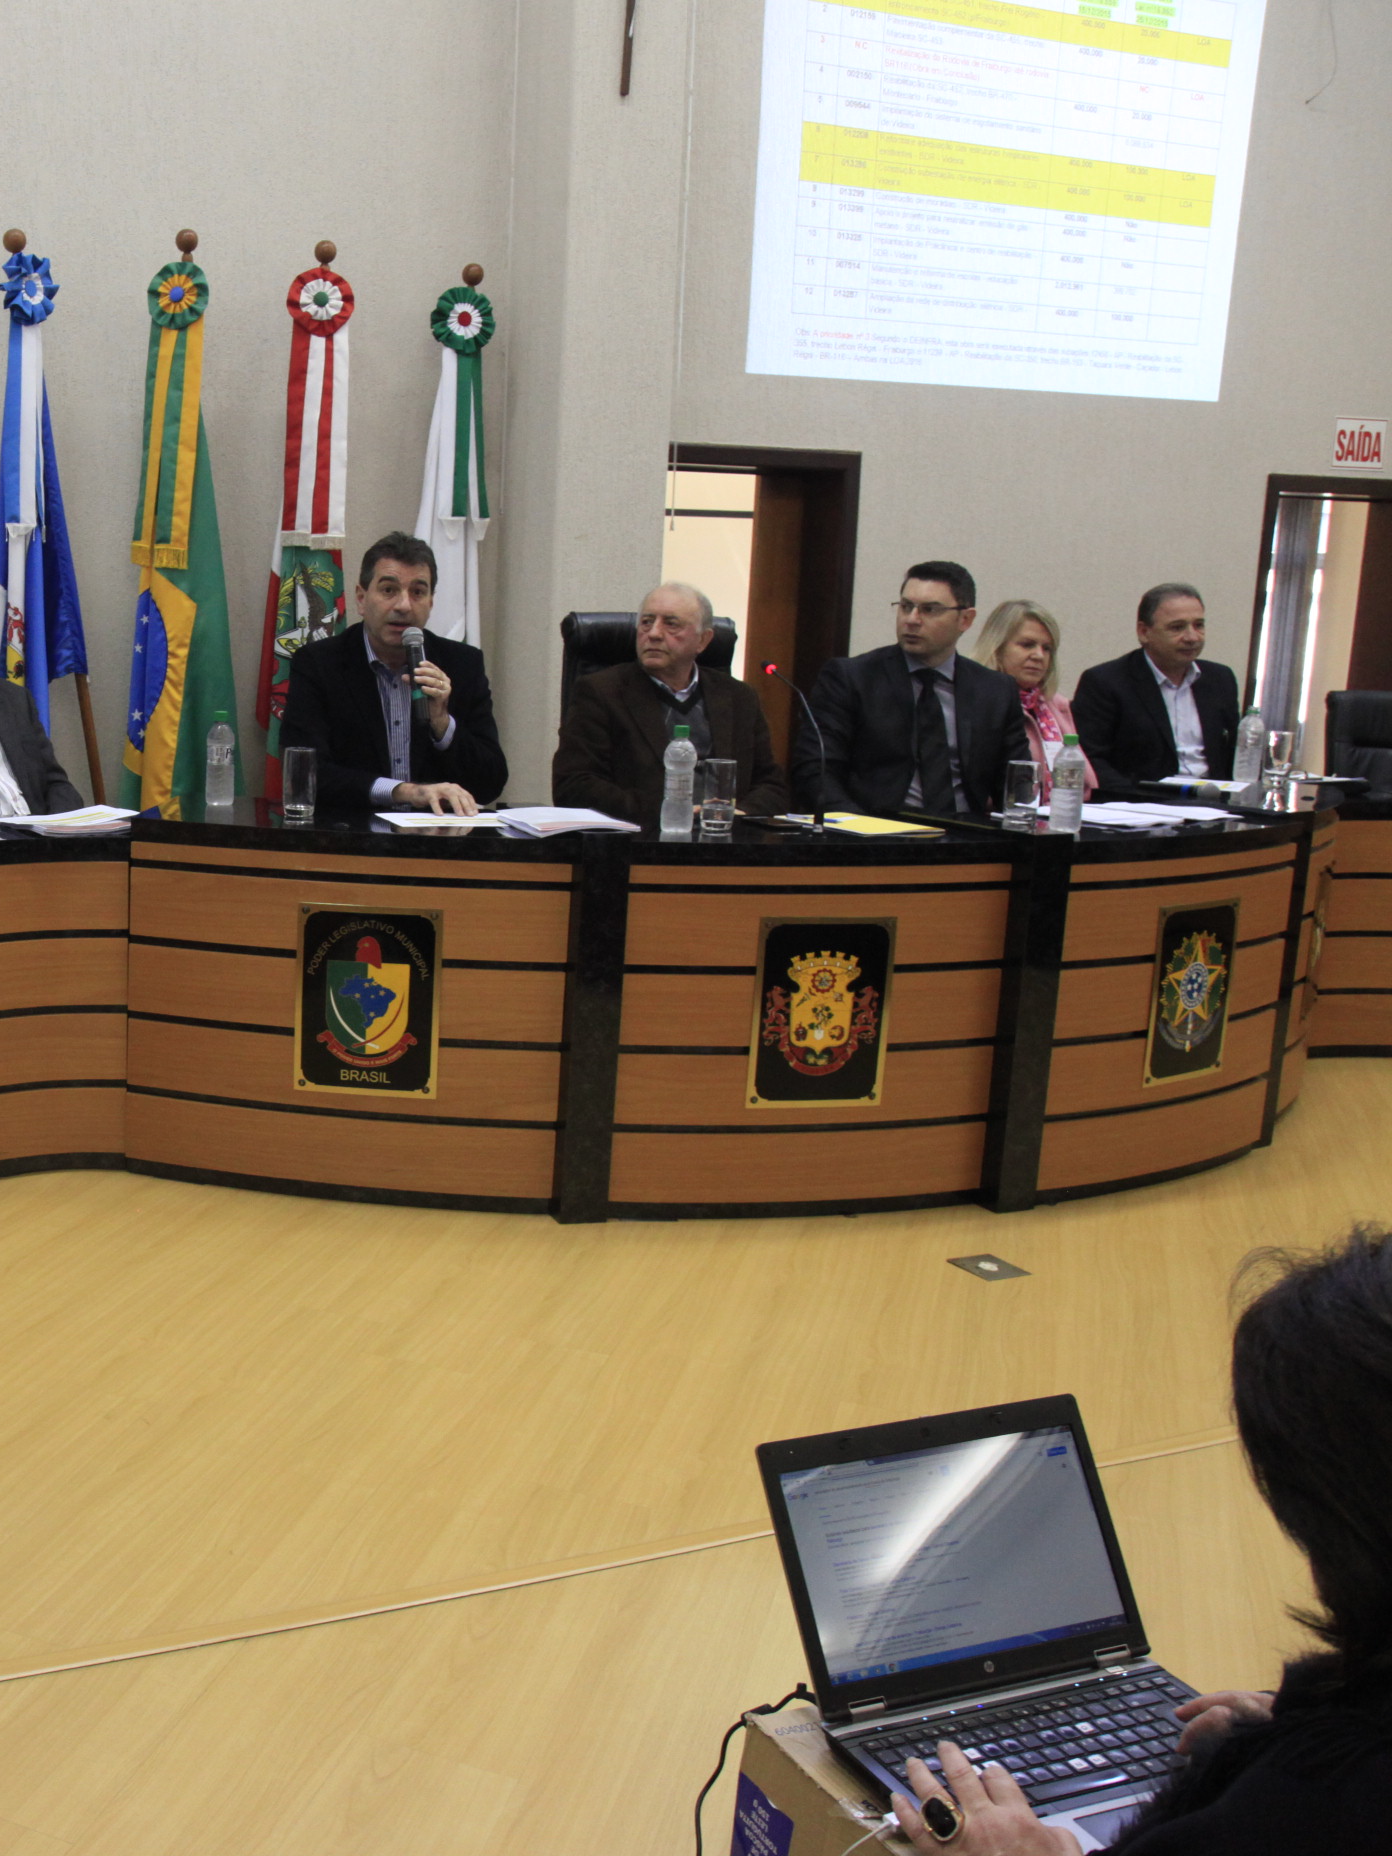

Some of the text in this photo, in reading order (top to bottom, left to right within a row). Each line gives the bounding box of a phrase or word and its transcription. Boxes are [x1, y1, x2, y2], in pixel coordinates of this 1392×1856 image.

[1335, 424, 1382, 463] SAÍDA
[308, 920, 430, 981] PODER LEGISLATIVO MUNICIPAL
[340, 1069, 391, 1084] BRASIL
[739, 1809, 778, 1856] TORTUGUITA
[751, 1810, 768, 1832] LEITE
